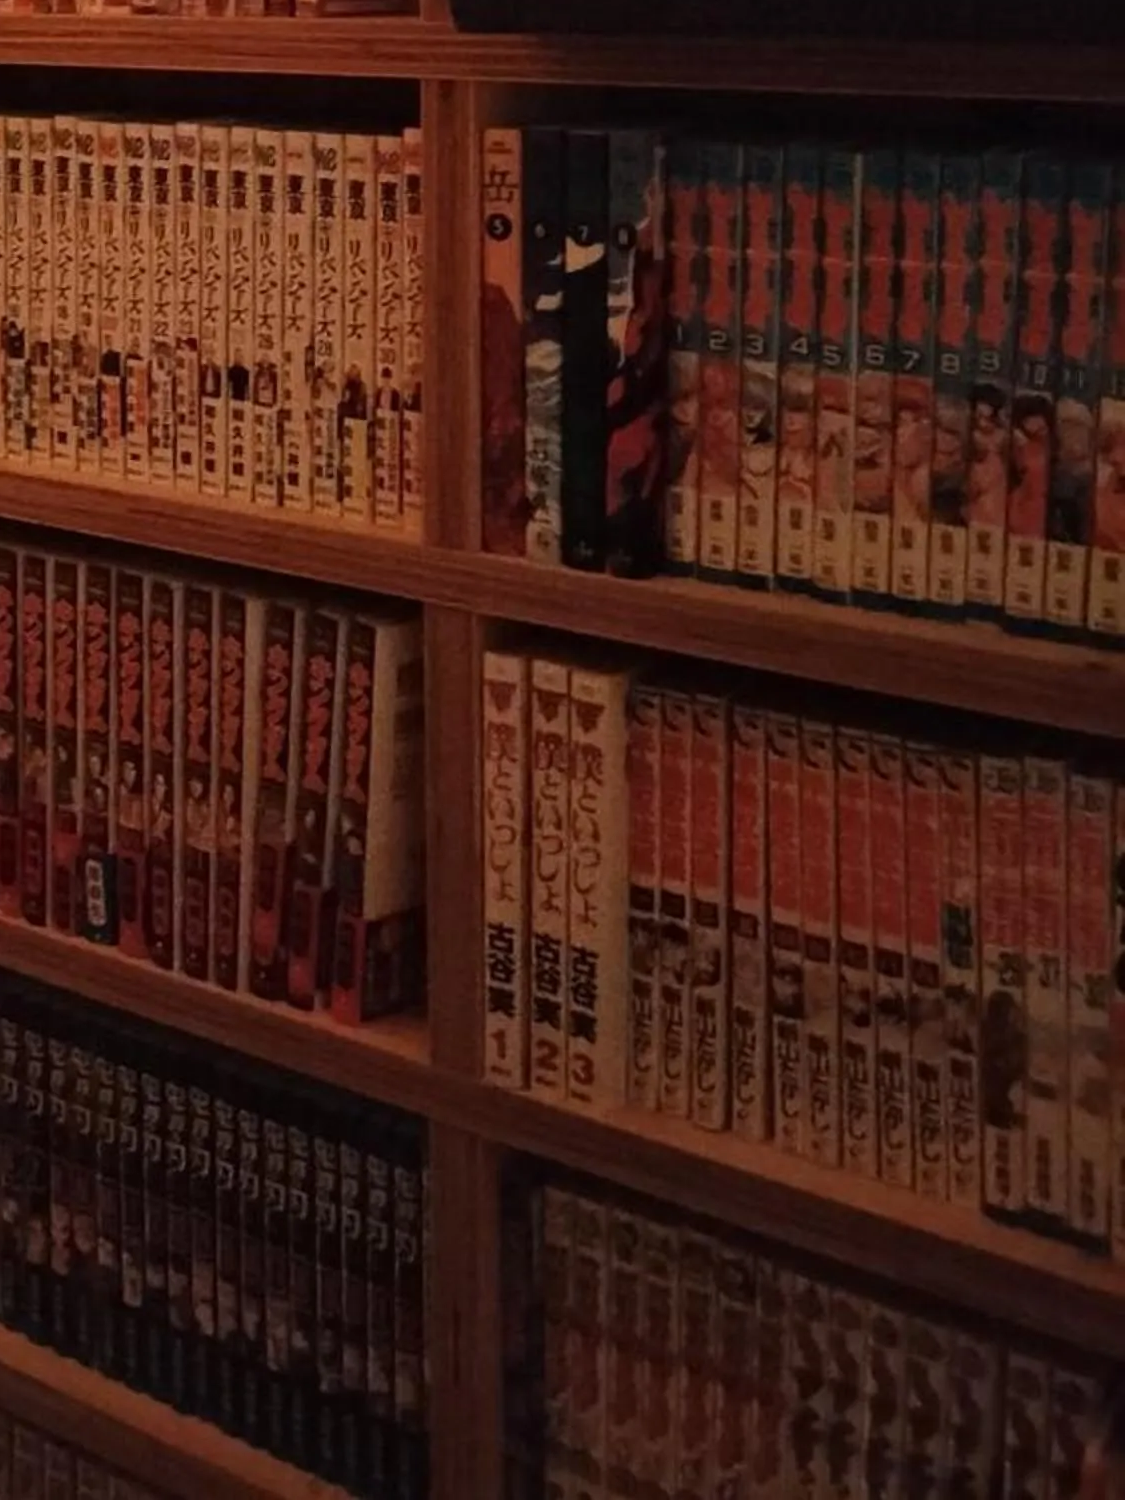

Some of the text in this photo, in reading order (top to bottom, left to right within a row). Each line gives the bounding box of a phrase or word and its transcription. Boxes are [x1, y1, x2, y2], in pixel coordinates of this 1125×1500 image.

[707, 329, 730, 352] 2
[745, 332, 765, 357] 3
[789, 330, 811, 355] 4
[821, 342, 843, 368] 5
[899, 348, 923, 372] 7
[490, 1029, 508, 1059] 1
[534, 1038, 559, 1071] 2
[570, 1053, 596, 1086] 3
